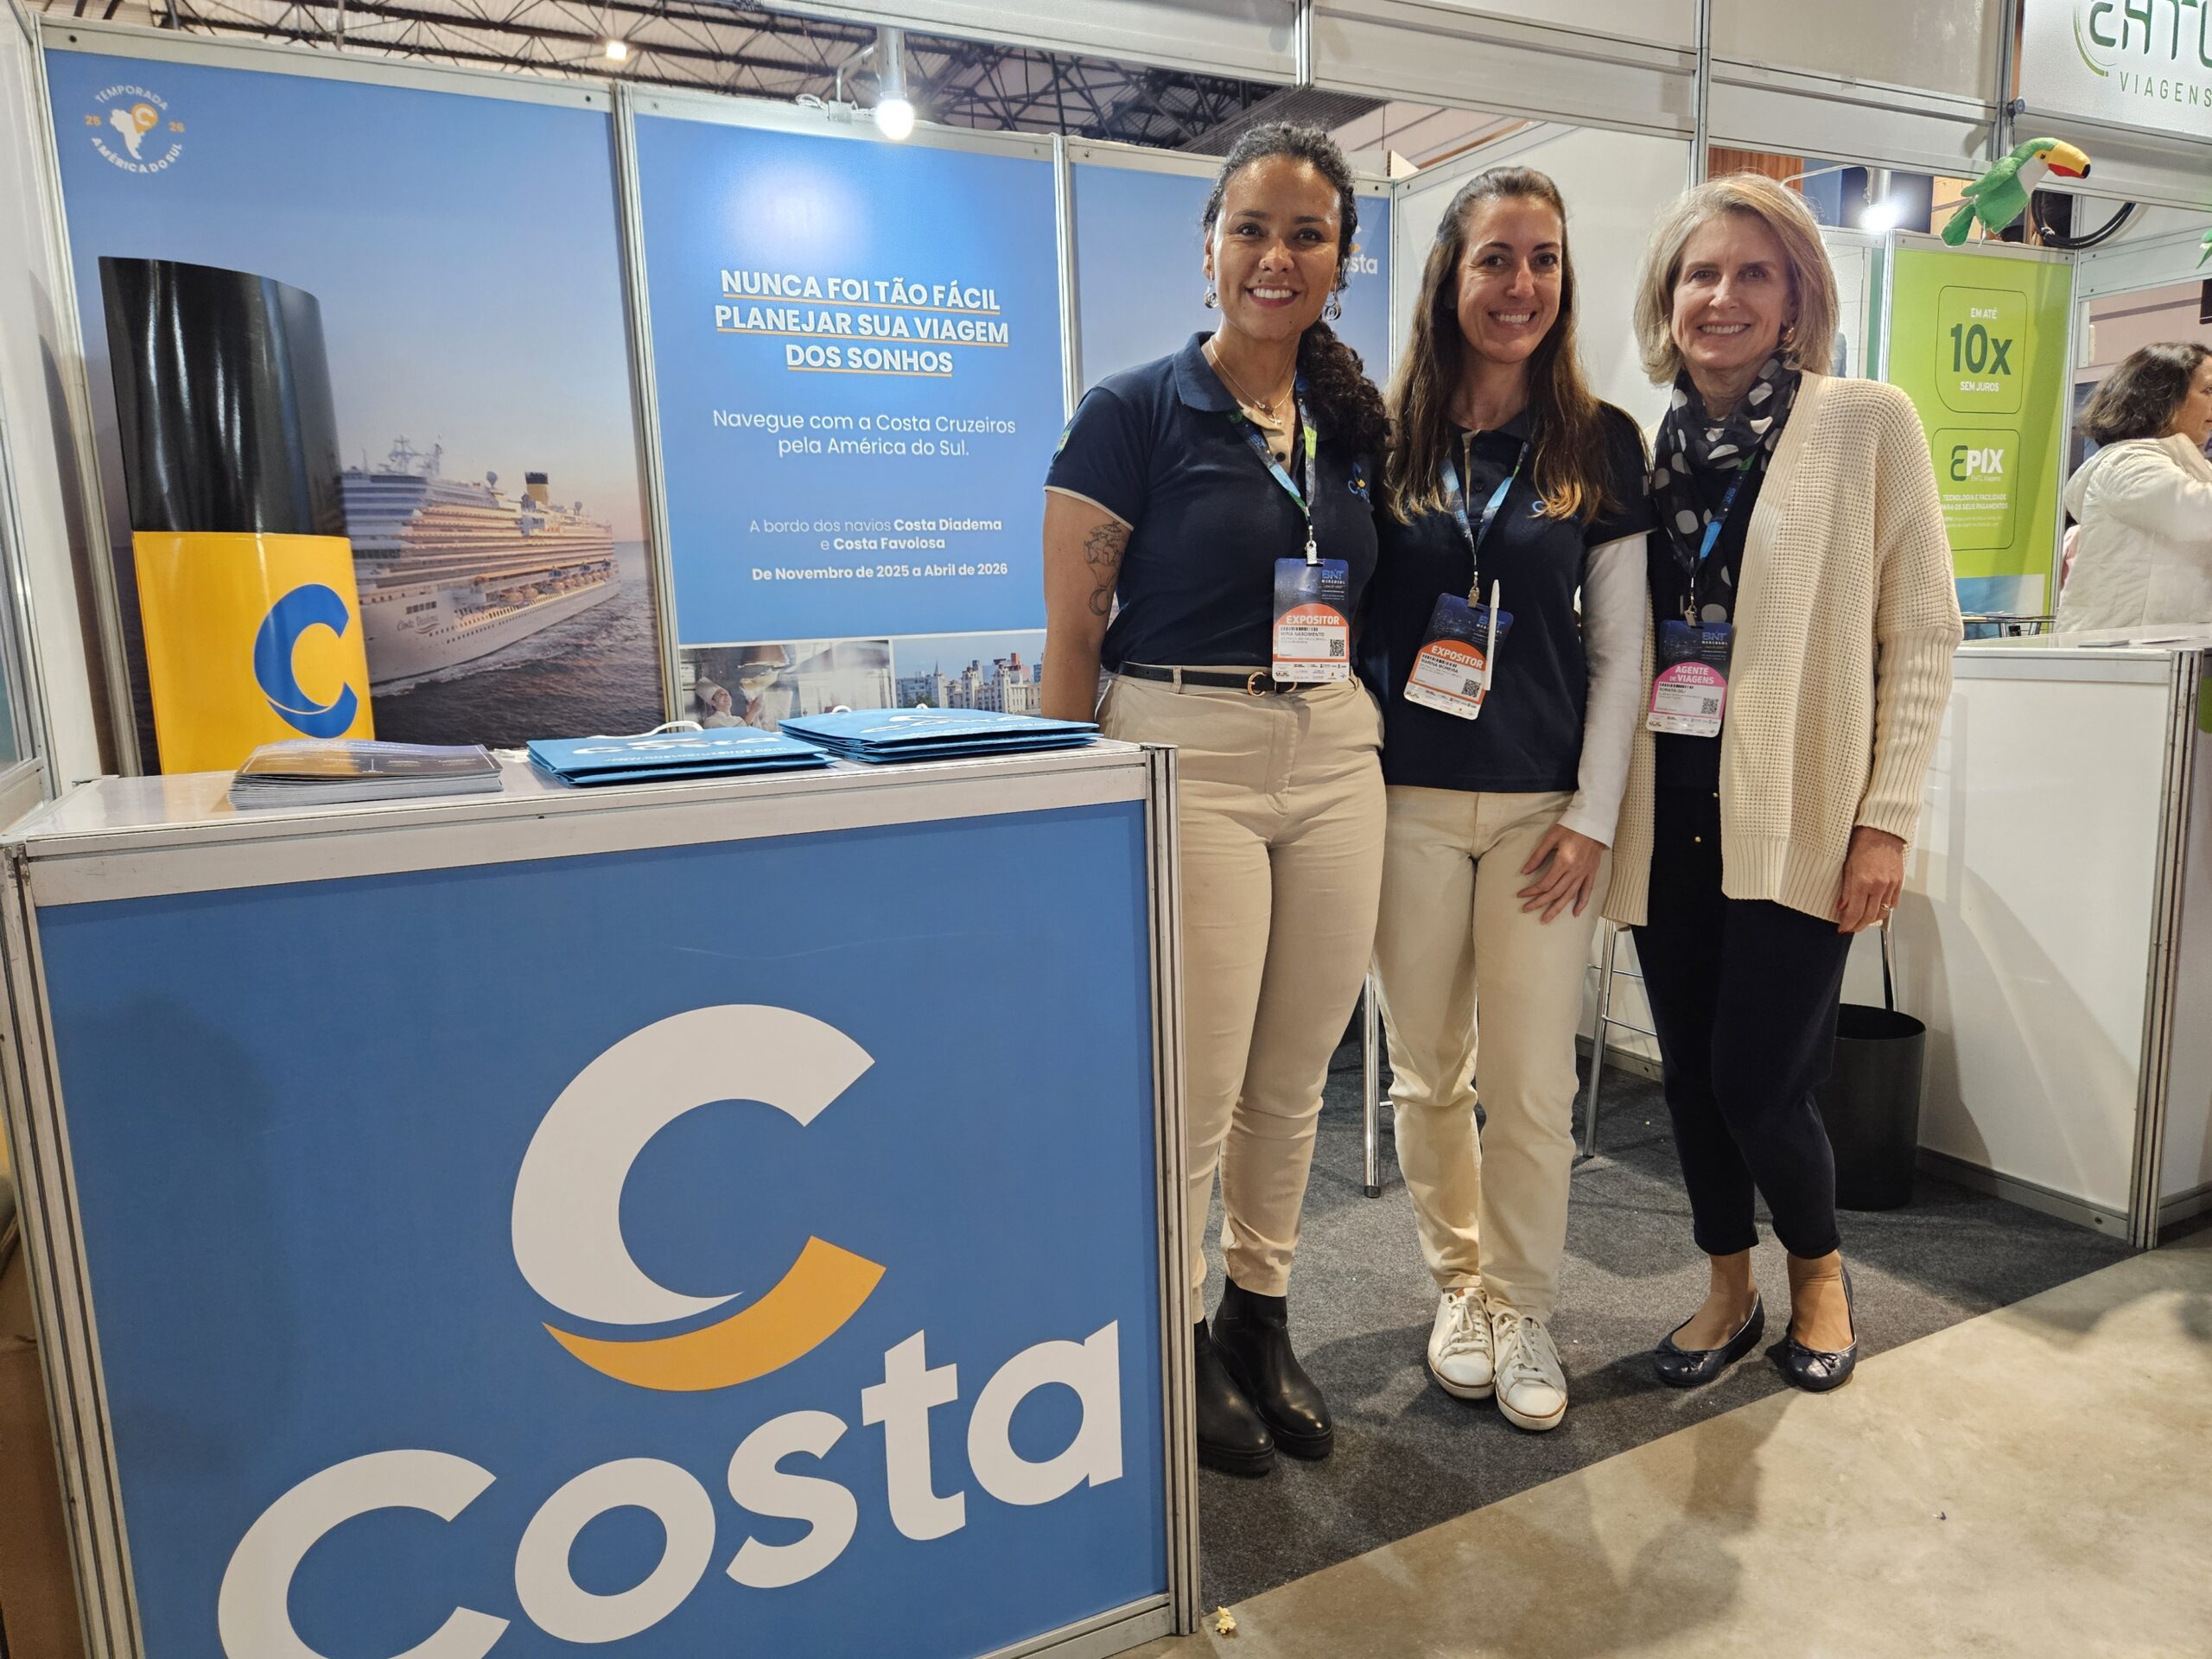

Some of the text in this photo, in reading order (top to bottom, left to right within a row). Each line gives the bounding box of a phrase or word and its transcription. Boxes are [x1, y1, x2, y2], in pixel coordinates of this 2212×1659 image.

[95, 85, 168, 111] TEMPORADA
[2120, 71, 2212, 108] VIAGENS
[92, 137, 182, 173] AMÉRICA DO SUL
[721, 269, 1001, 310] NUNCA FOI TÃO FÁCIL
[715, 304, 1009, 344] PLANEJAR SUA VIAGEM
[1970, 306, 1998, 320] EM ATÉ
[785, 343, 953, 373] DOS SONHOS
[1950, 323, 2013, 375] 10x
[1960, 381, 1999, 392] SEM JUROS
[713, 410, 1016, 434] Navegue com a Costa Cruzeiros
[779, 437, 970, 458] pela América do Sul.
[749, 518, 1002, 533] A bordo dos navios Costa Diadema
[821, 536, 946, 550] e Costa Favolosa
[752, 563, 1008, 581] De Novembro de 2025 a Abril de 2026
[1286, 614, 1340, 626] EXPOSITOR
[1431, 645, 1484, 669] EXPOSITOR
[1675, 665, 1709, 676] AGENTE
[1678, 674, 1714, 684] VIAGENS
[218, 1319, 1123, 1659] Costa
